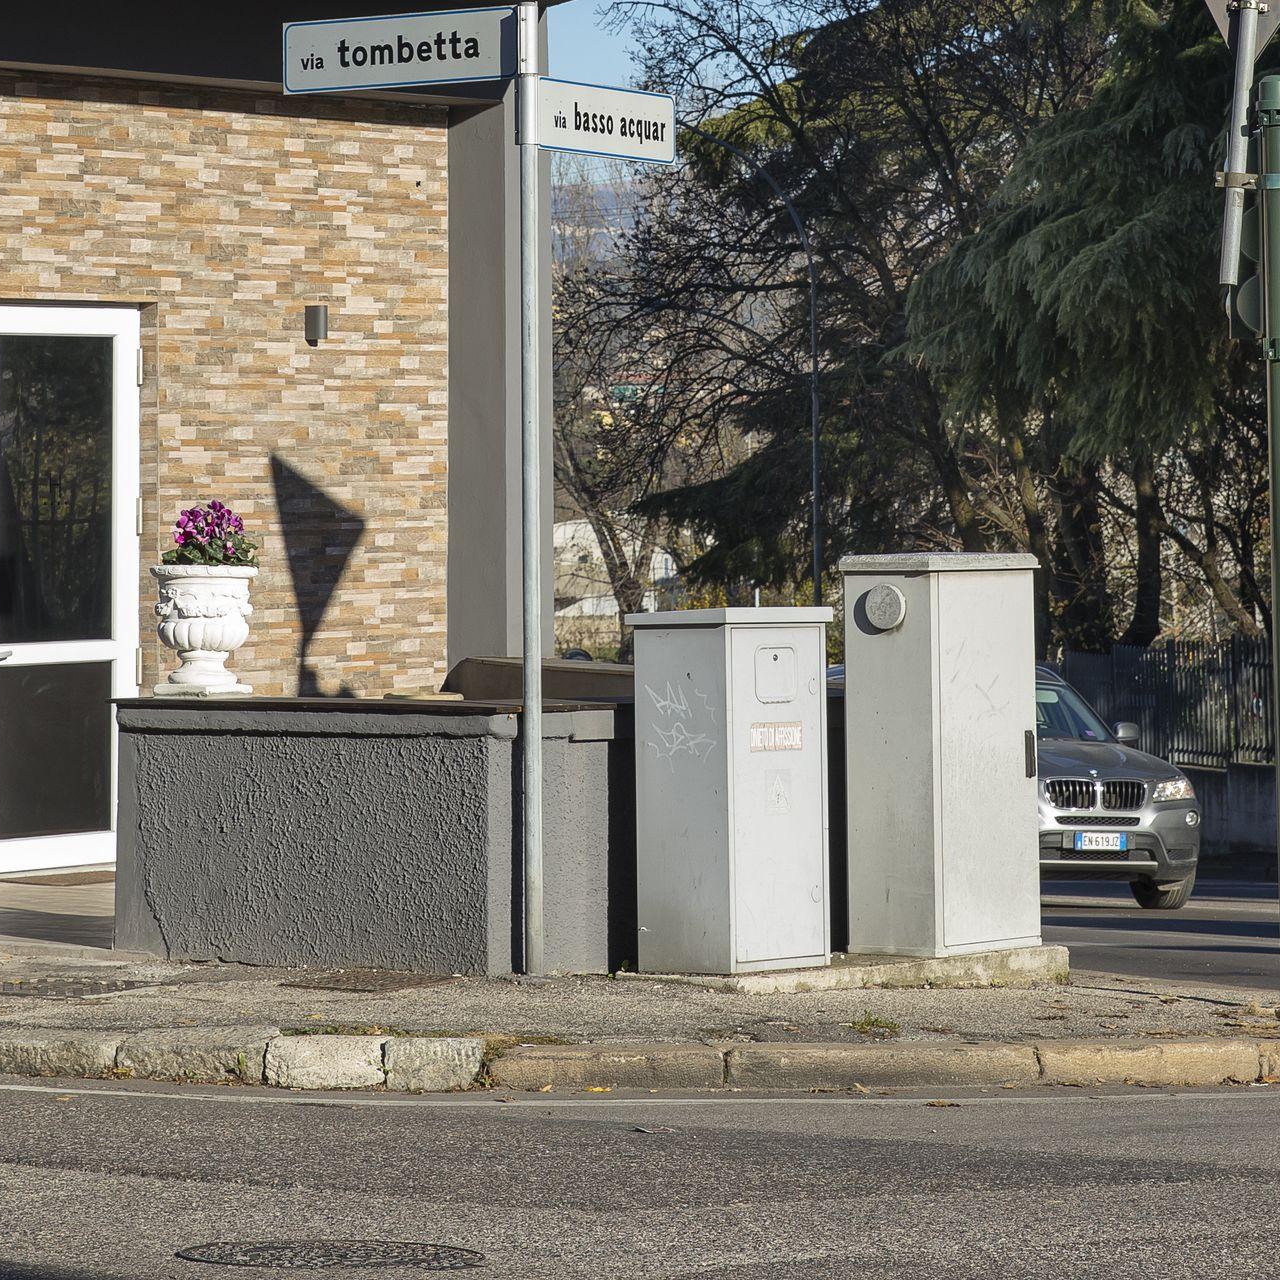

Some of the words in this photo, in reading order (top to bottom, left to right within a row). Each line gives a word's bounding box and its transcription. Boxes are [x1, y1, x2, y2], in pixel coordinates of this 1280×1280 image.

[301, 53, 324, 70] via
[337, 30, 480, 68] tombetta
[554, 110, 567, 129] via
[574, 102, 613, 135] basso
[620, 117, 666, 144] acquar
